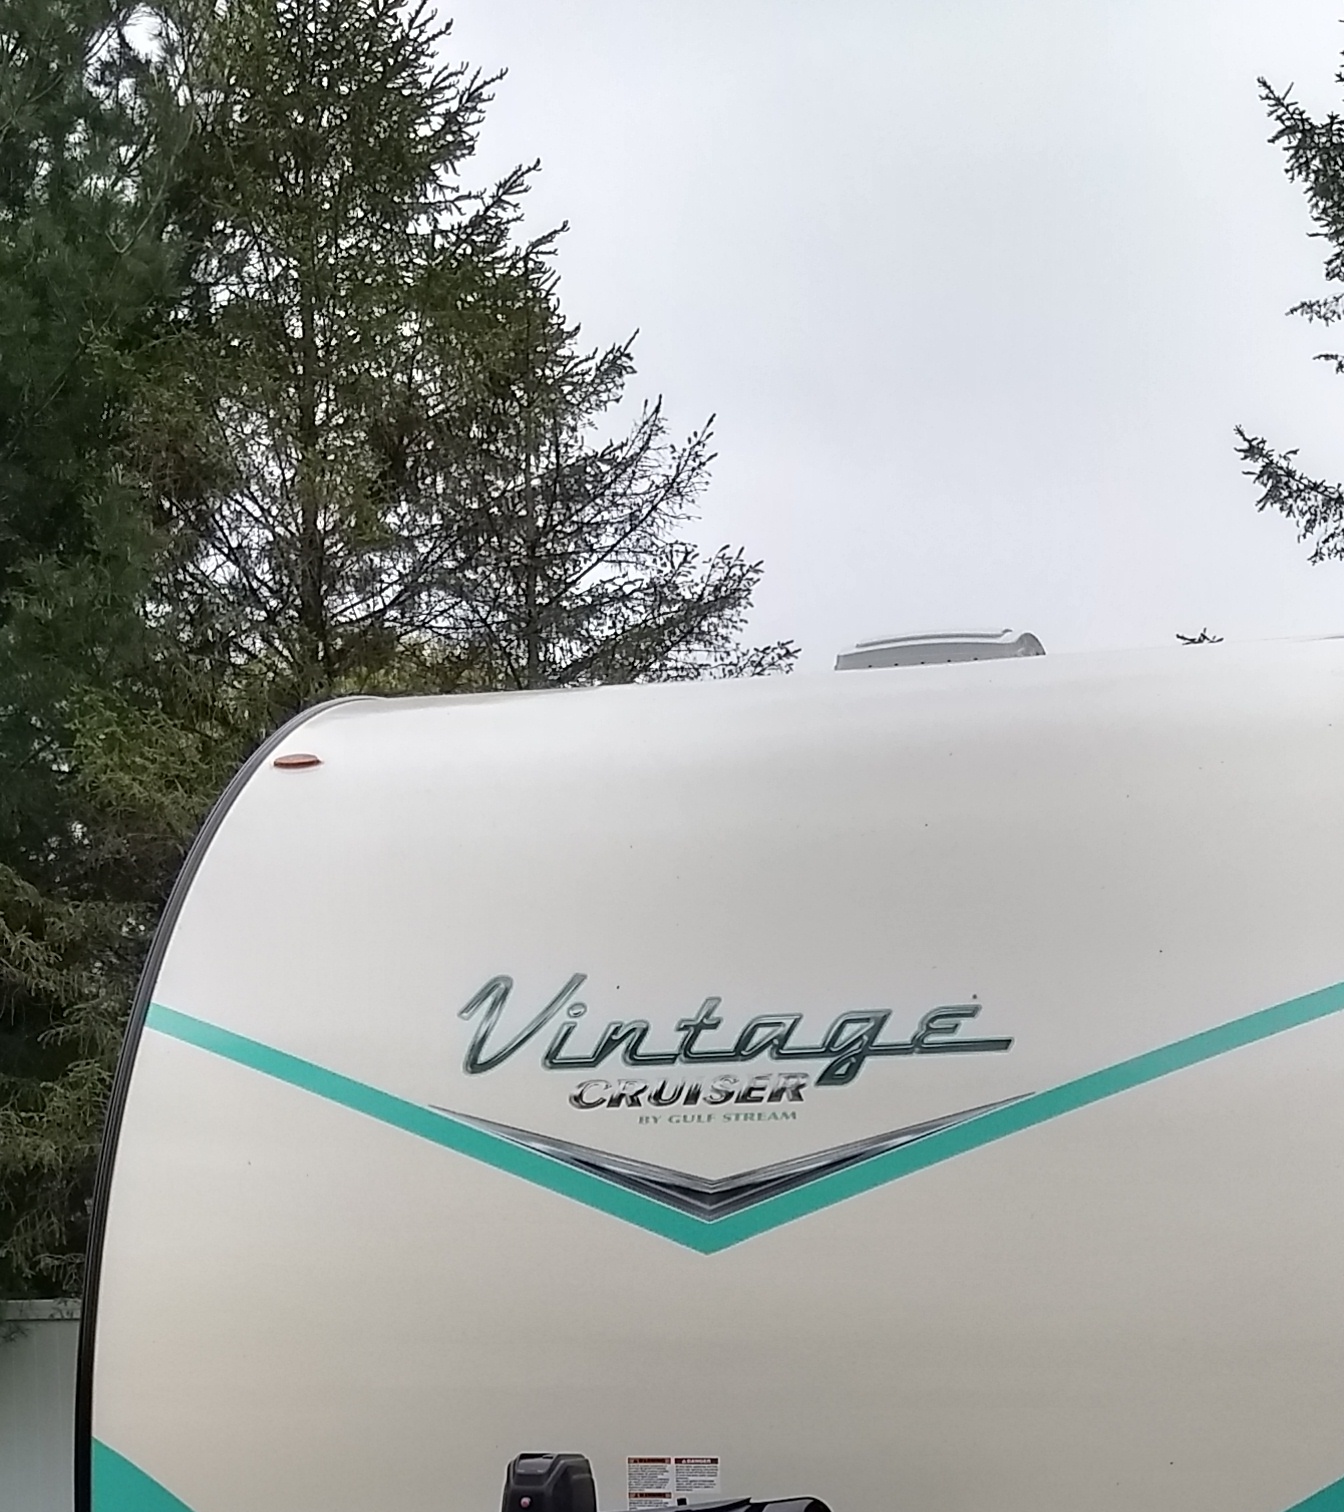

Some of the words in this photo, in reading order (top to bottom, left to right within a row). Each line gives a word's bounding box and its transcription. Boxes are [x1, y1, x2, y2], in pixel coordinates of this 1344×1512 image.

[458, 972, 1014, 1086] Vintage
[568, 1072, 809, 1110] CRUISER
[638, 1115, 661, 1125] BY
[668, 1113, 716, 1124] GULF
[722, 1110, 798, 1122] STREAM
